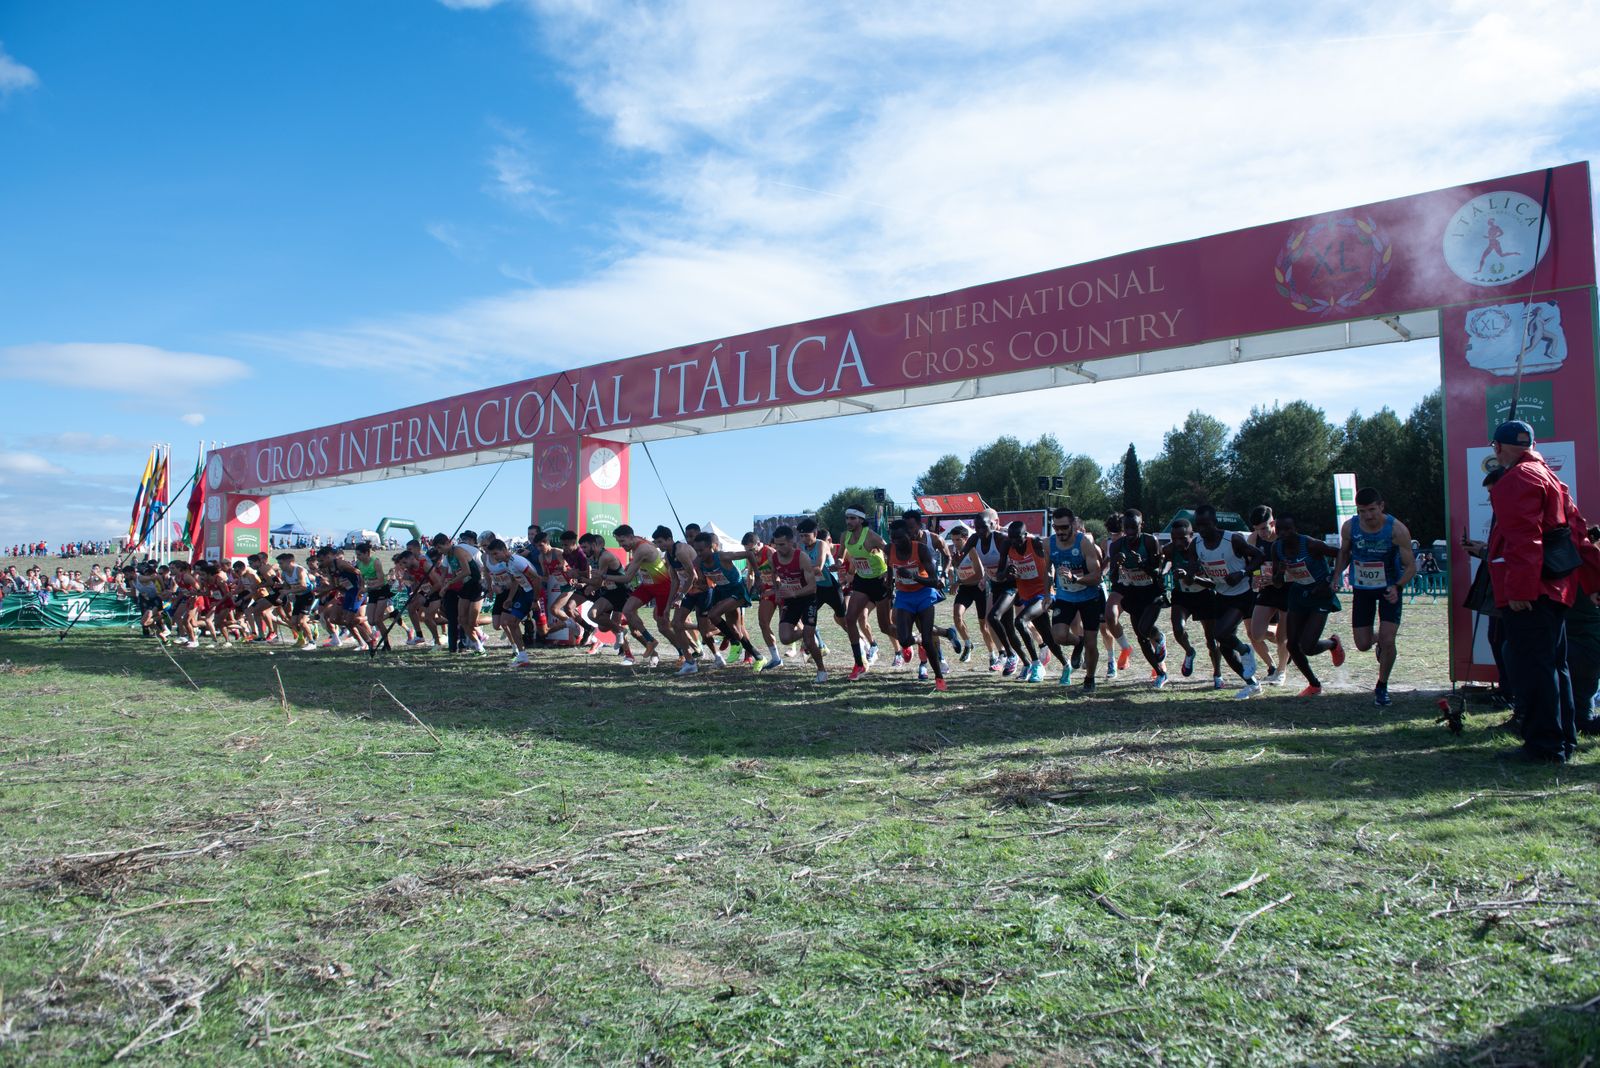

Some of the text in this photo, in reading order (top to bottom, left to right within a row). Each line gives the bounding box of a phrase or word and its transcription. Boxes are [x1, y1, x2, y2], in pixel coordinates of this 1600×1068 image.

[1311, 241, 1361, 278] XL
[904, 266, 1165, 340] INTERNATIONAL
[902, 308, 1185, 379] CROSS COUNTRY
[1481, 318, 1501, 332] XL
[256, 329, 875, 484] CROSS INTERNACIONAL ITÁLICA
[1494, 395, 1545, 409] DIPUACIÓN
[1359, 570, 1380, 579] 1607
